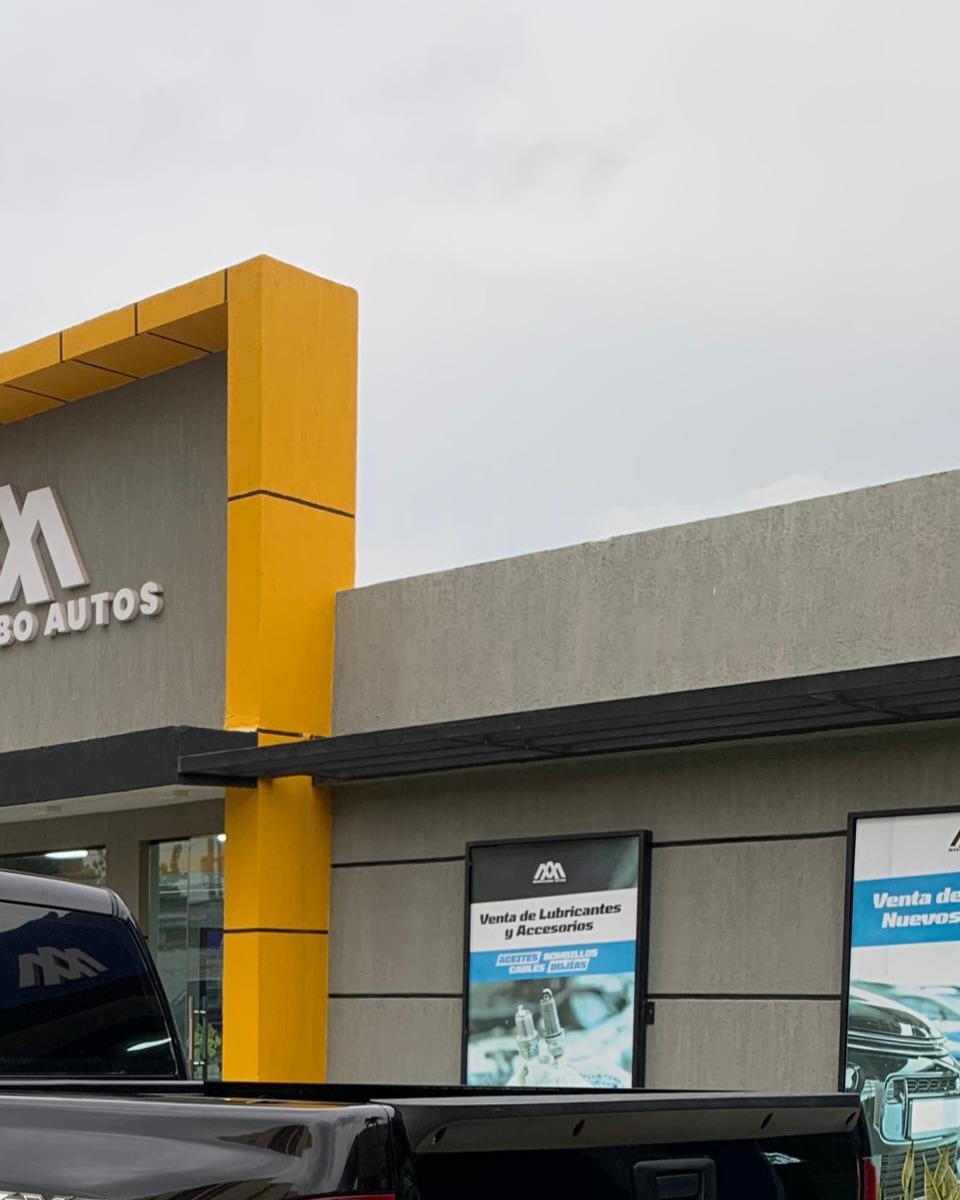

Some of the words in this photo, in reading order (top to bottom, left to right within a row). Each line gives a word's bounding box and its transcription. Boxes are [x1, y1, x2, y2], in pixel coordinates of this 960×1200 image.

[44, 582, 163, 636] AUTOS
[872, 890, 933, 910] Venta
[935, 886, 960, 905] de
[480, 912, 517, 926] Venta
[520, 909, 537, 922] de
[539, 903, 622, 921] Lubricantes
[881, 911, 960, 929] Nuevos
[504, 928, 514, 940] y
[516, 920, 594, 937] Accesorios
